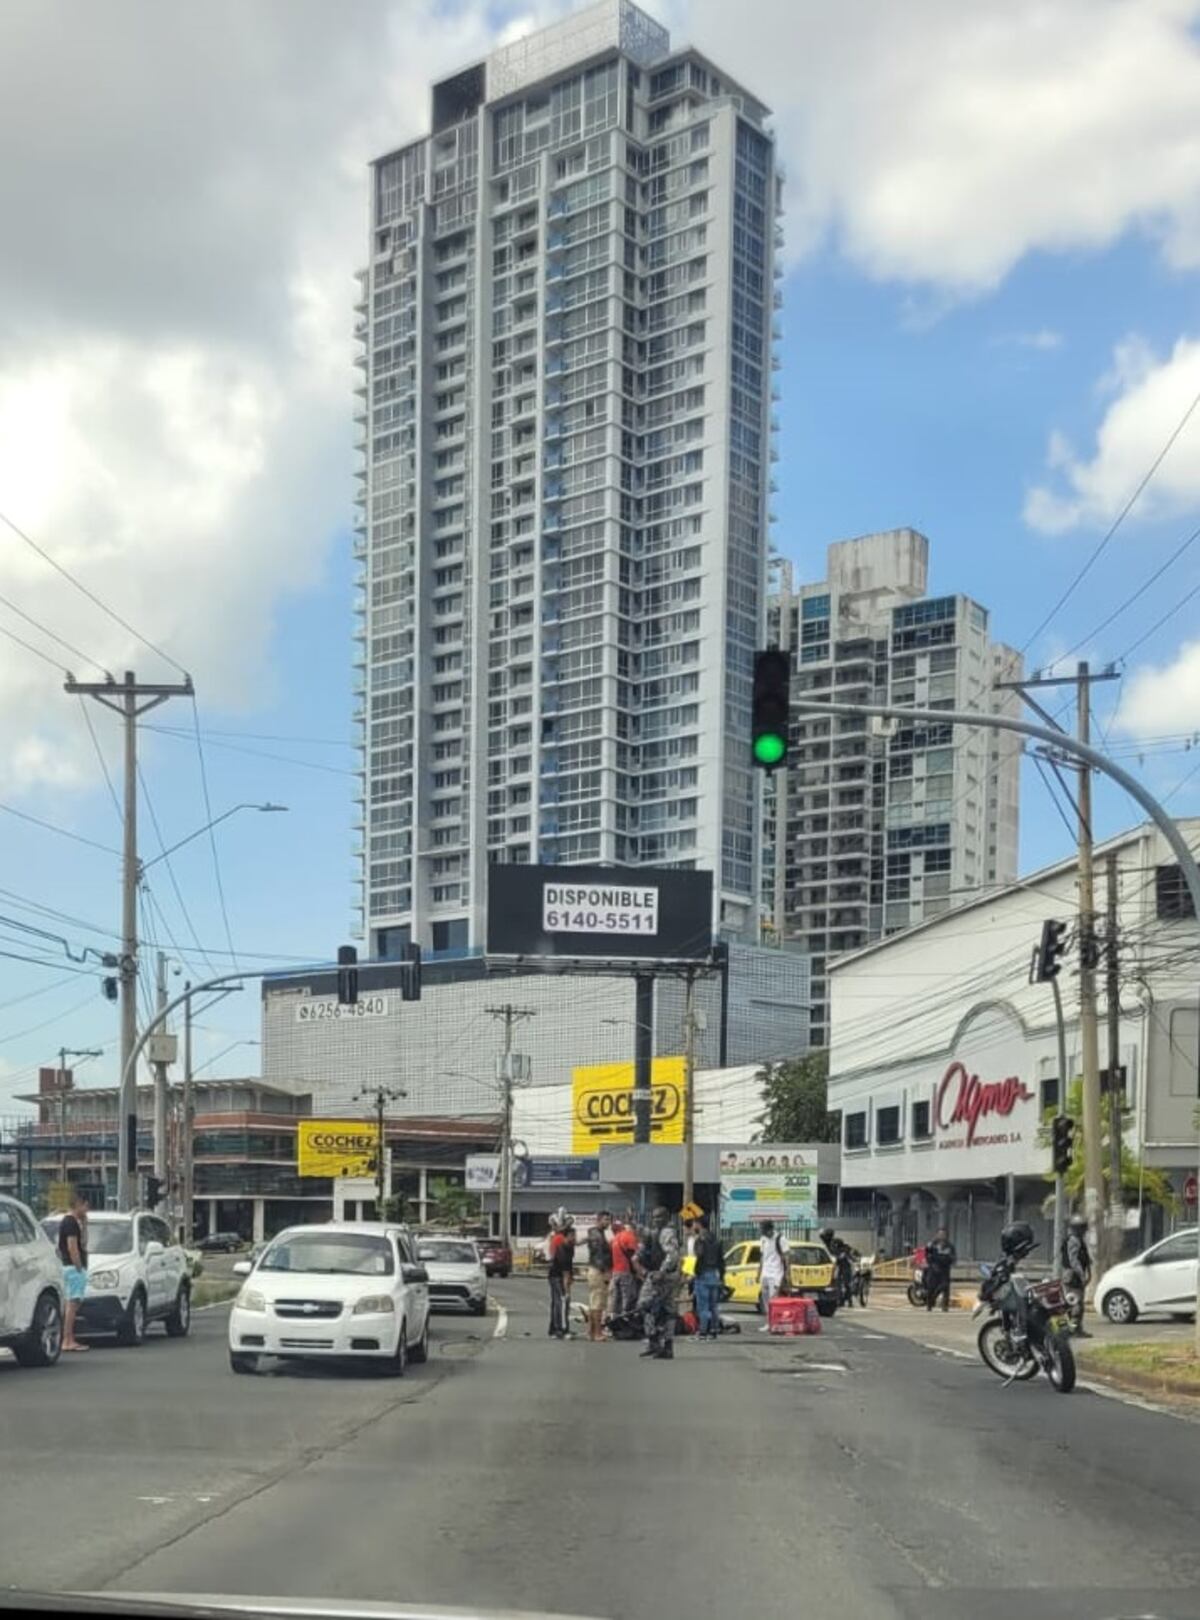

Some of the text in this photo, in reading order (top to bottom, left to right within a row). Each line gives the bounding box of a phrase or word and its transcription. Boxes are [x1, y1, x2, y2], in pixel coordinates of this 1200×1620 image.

[546, 888, 655, 908] DISPONIBLE
[546, 910, 654, 930] 6140-5511
[586, 1088, 667, 1119] COCZ
[313, 1134, 374, 1148] COCHEZ
